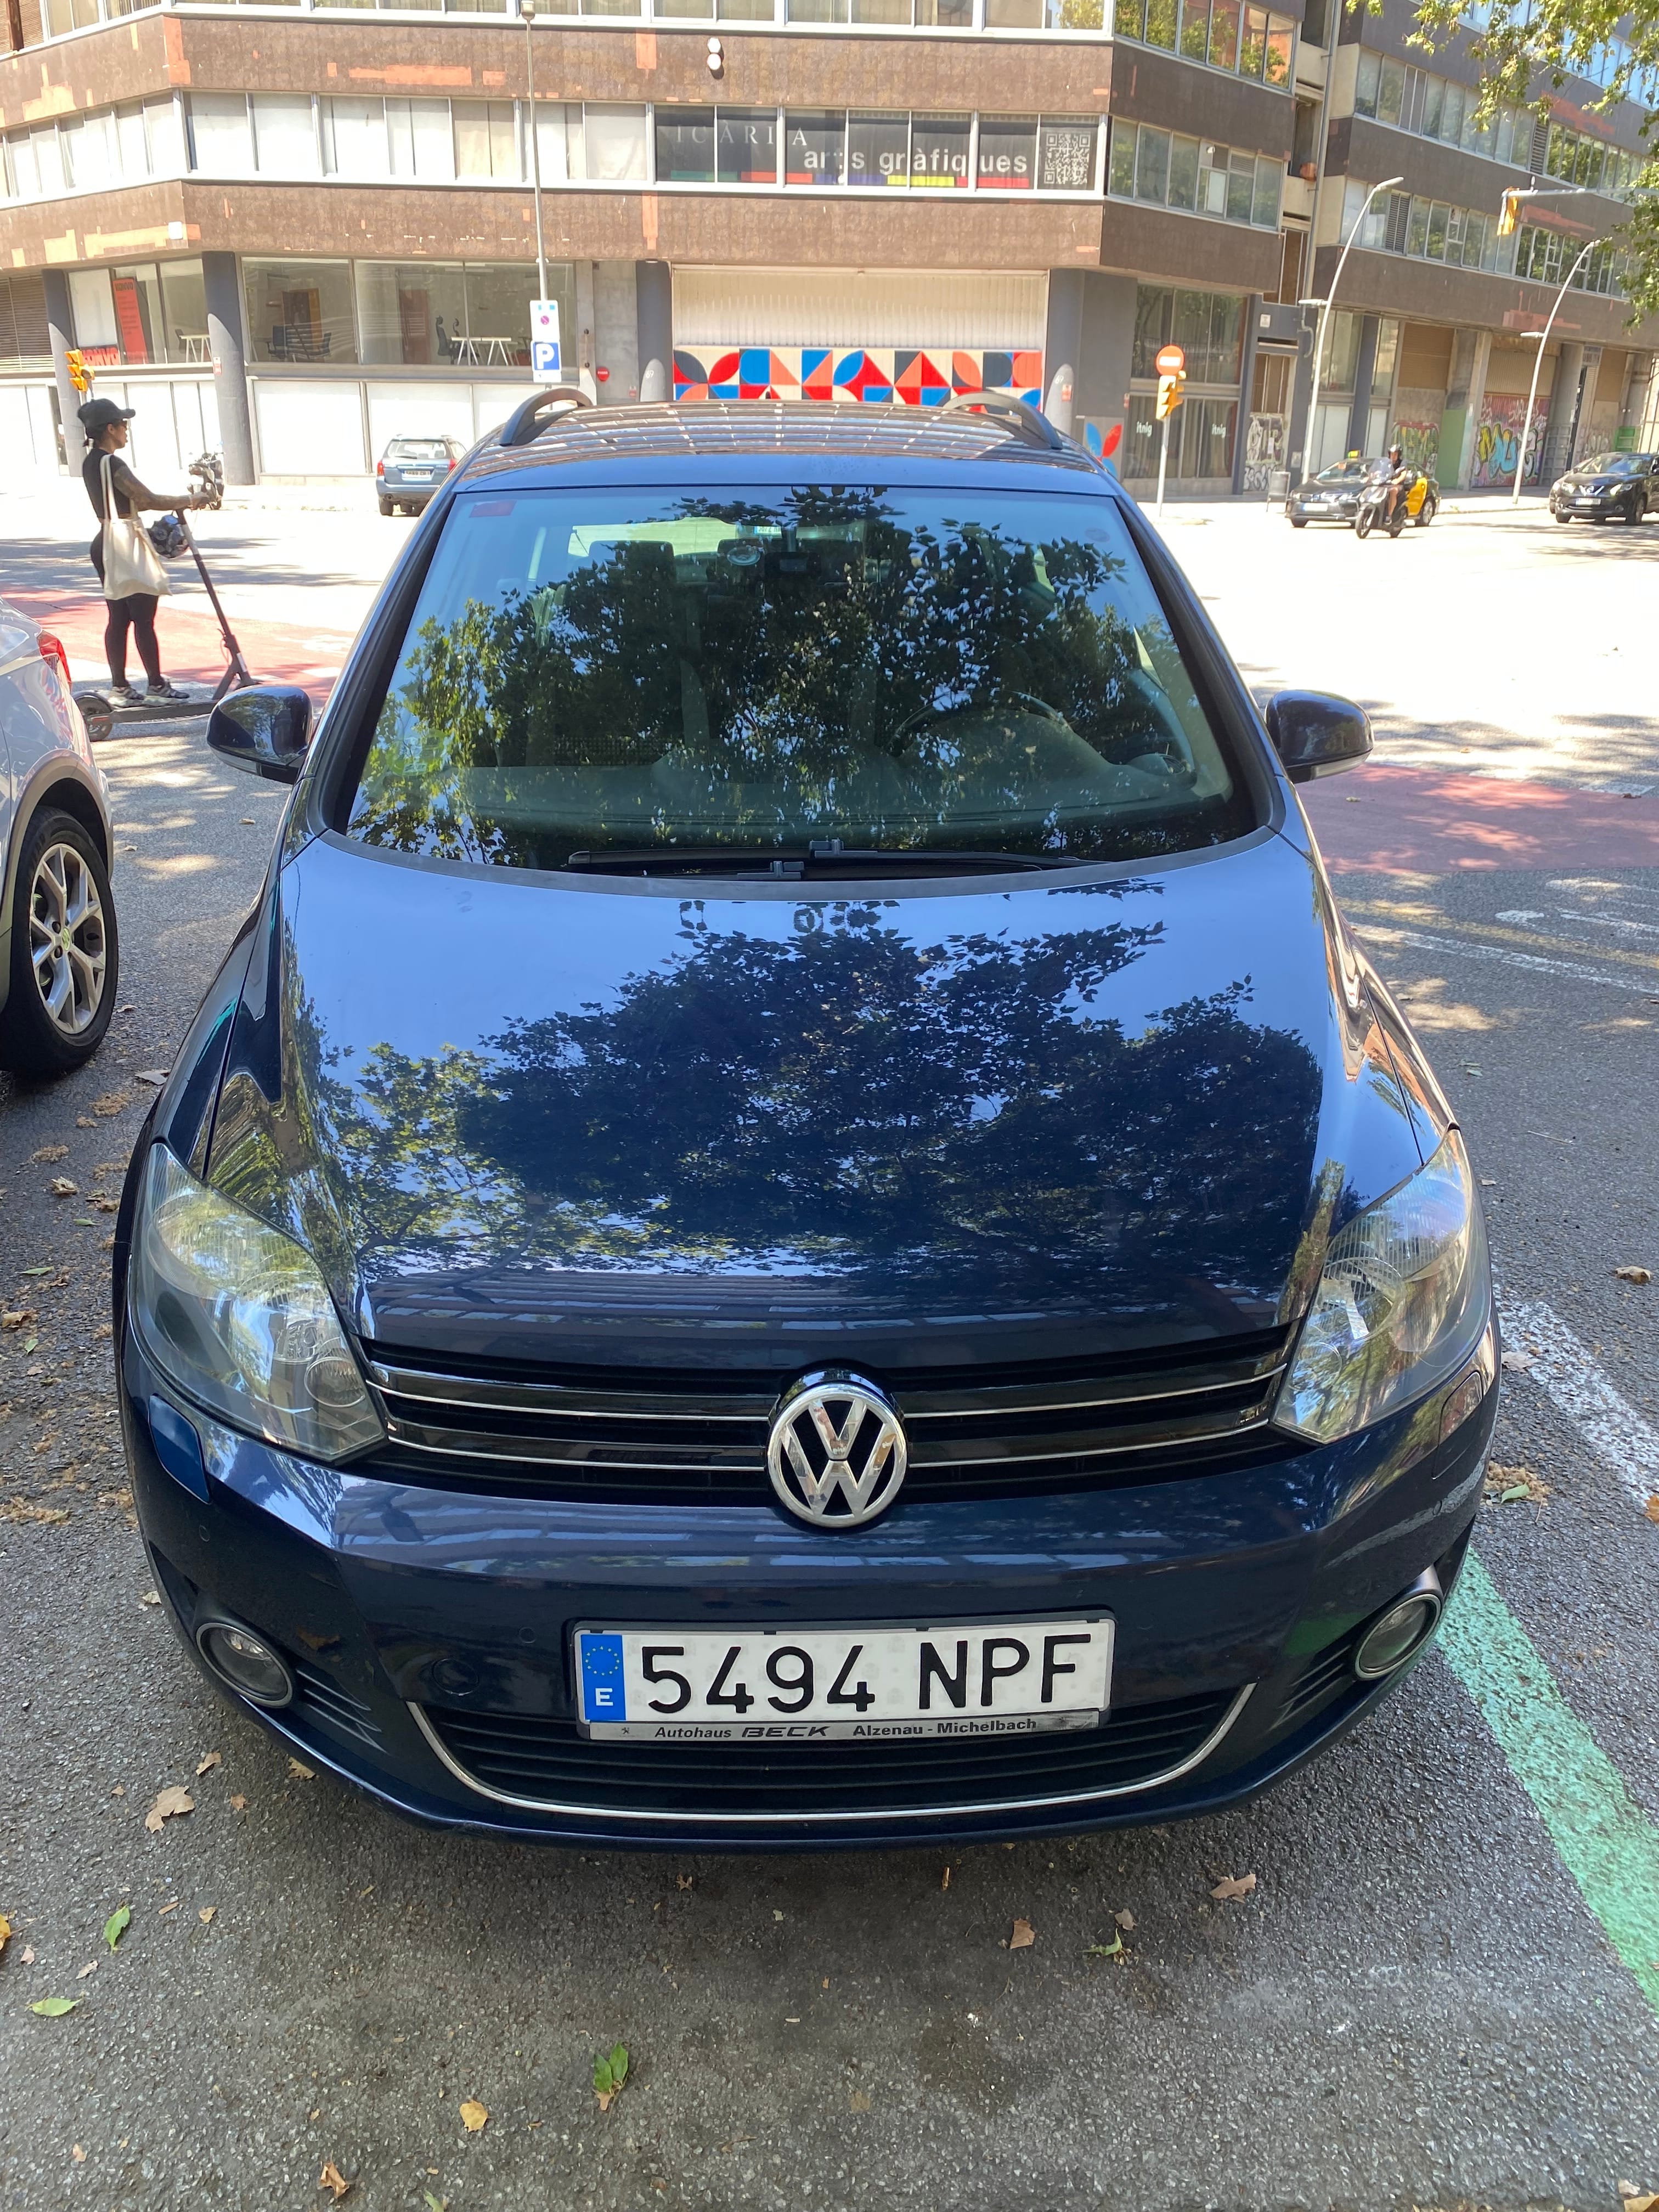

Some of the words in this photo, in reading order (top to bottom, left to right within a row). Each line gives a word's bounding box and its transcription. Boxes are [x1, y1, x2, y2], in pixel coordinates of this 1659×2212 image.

[676, 120, 808, 146] ICÀRIA
[879, 148, 1028, 177] gràfiques
[535, 343, 555, 370] P
[1136, 421, 1153, 437] itnig
[1211, 423, 1226, 439] itnig
[642, 1645, 876, 1713] 5494
[918, 1633, 1091, 1709] NPF
[595, 1688, 614, 1707] E
[654, 1726, 732, 1738] Autohaus
[741, 1726, 831, 1738] BECK
[853, 1724, 923, 1737] Alzenau
[937, 1718, 1037, 1734] Michelbach
